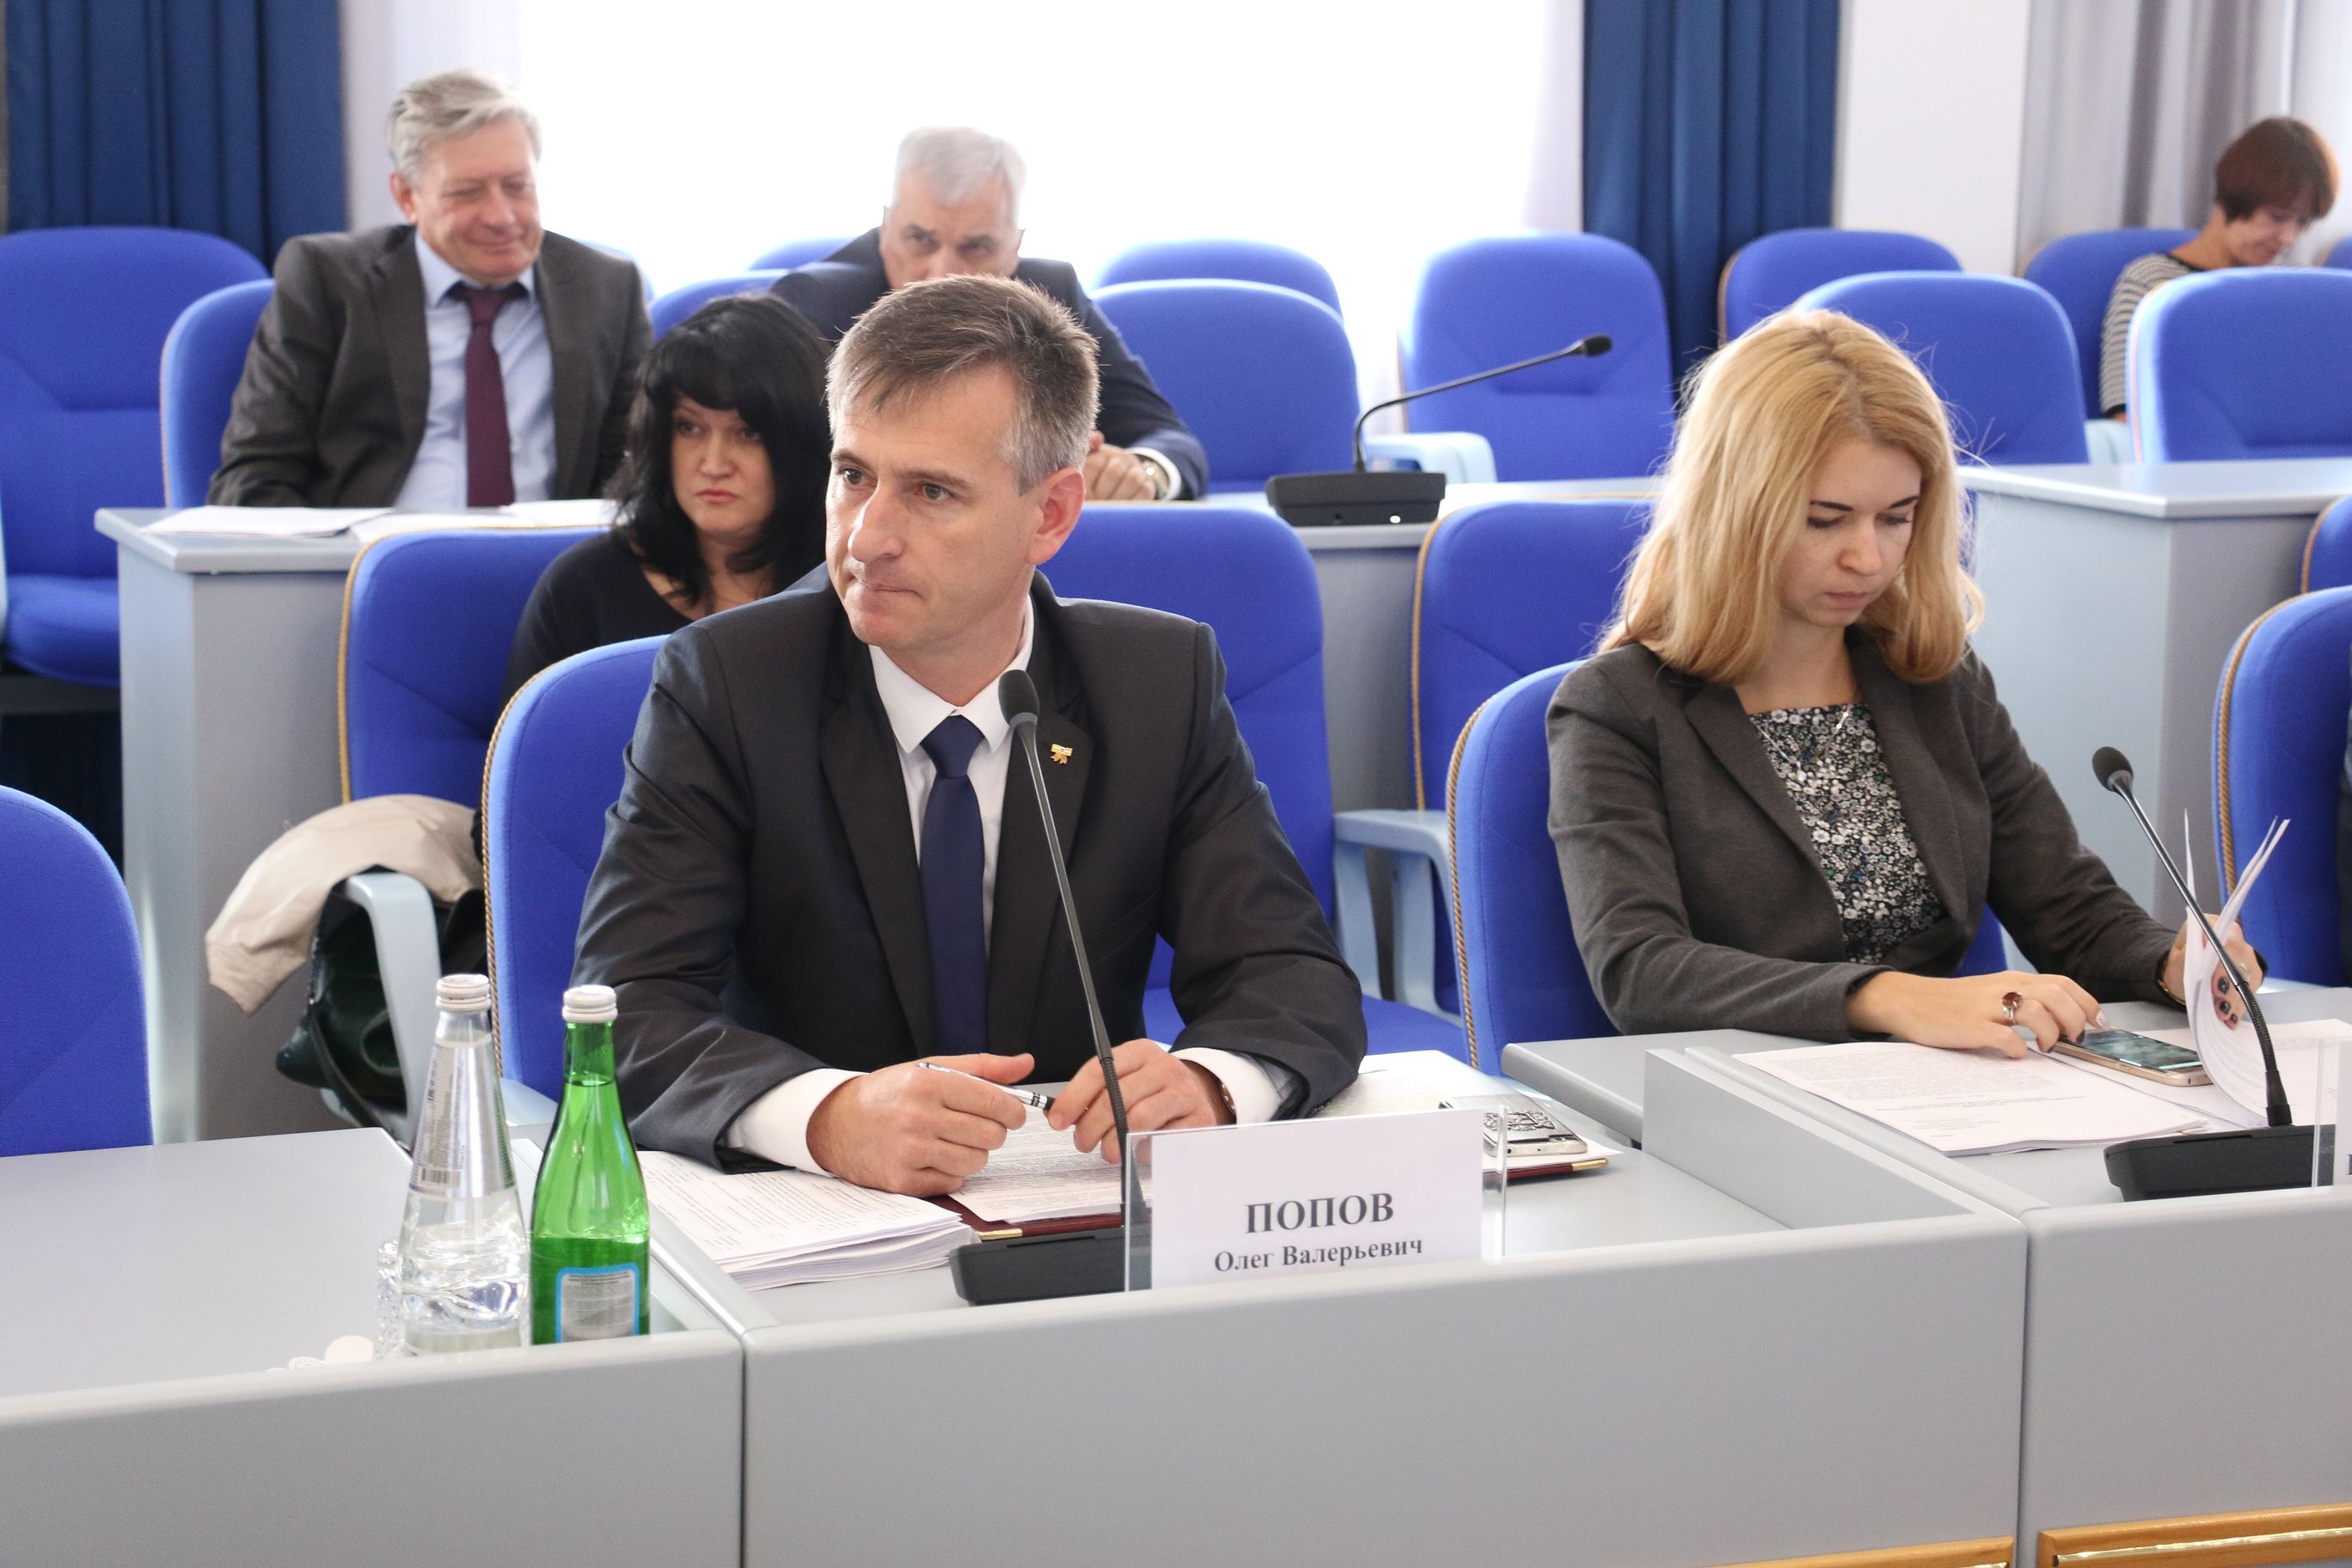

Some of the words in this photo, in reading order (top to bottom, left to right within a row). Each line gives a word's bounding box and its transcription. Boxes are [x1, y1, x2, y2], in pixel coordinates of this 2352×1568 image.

[1245, 1192, 1393, 1234] ПОПОВ
[1214, 1251, 1274, 1272] Олег
[1282, 1239, 1423, 1267] Валерьевич
